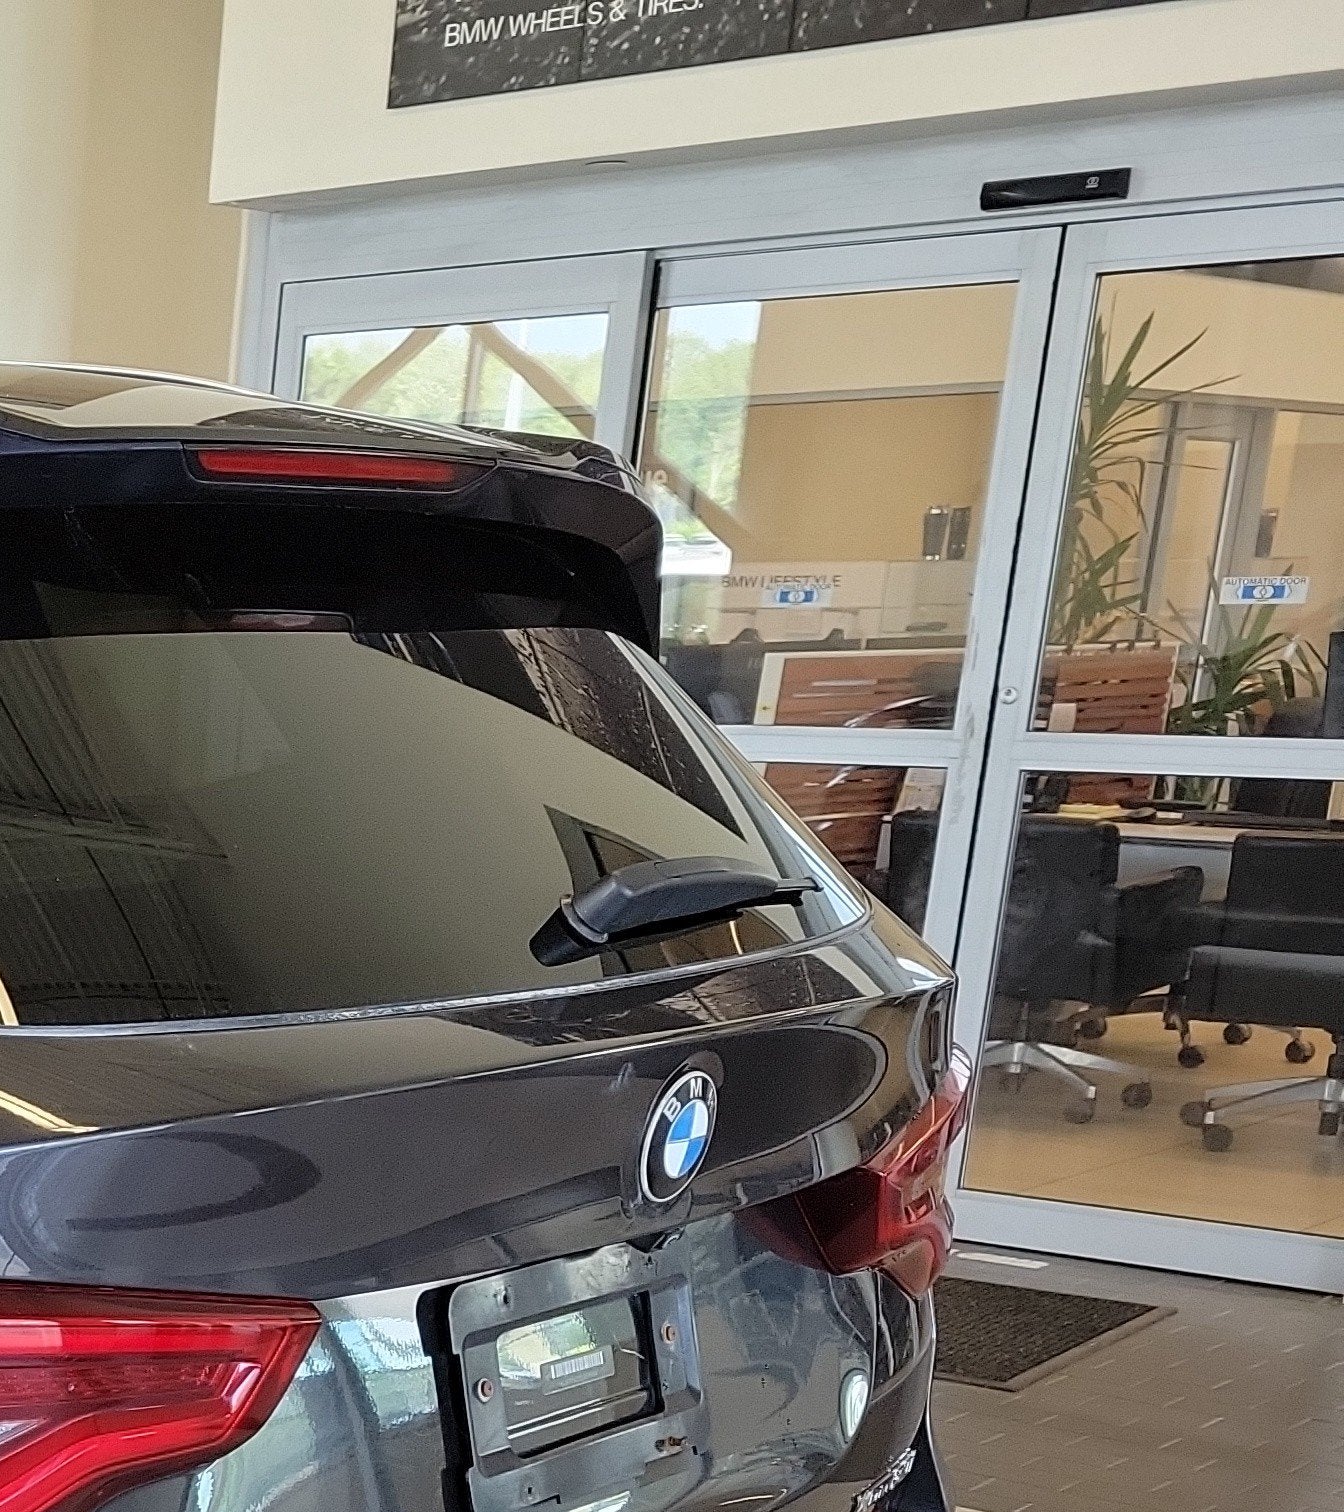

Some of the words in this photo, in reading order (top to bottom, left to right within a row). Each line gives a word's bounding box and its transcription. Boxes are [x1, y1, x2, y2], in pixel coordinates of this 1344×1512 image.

[444, 15, 505, 47] BMW
[508, 1, 603, 37] WHEELS
[609, 0, 626, 22] &
[1225, 577, 1277, 586] AUTOMATIC
[1280, 577, 1307, 585] DOOR
